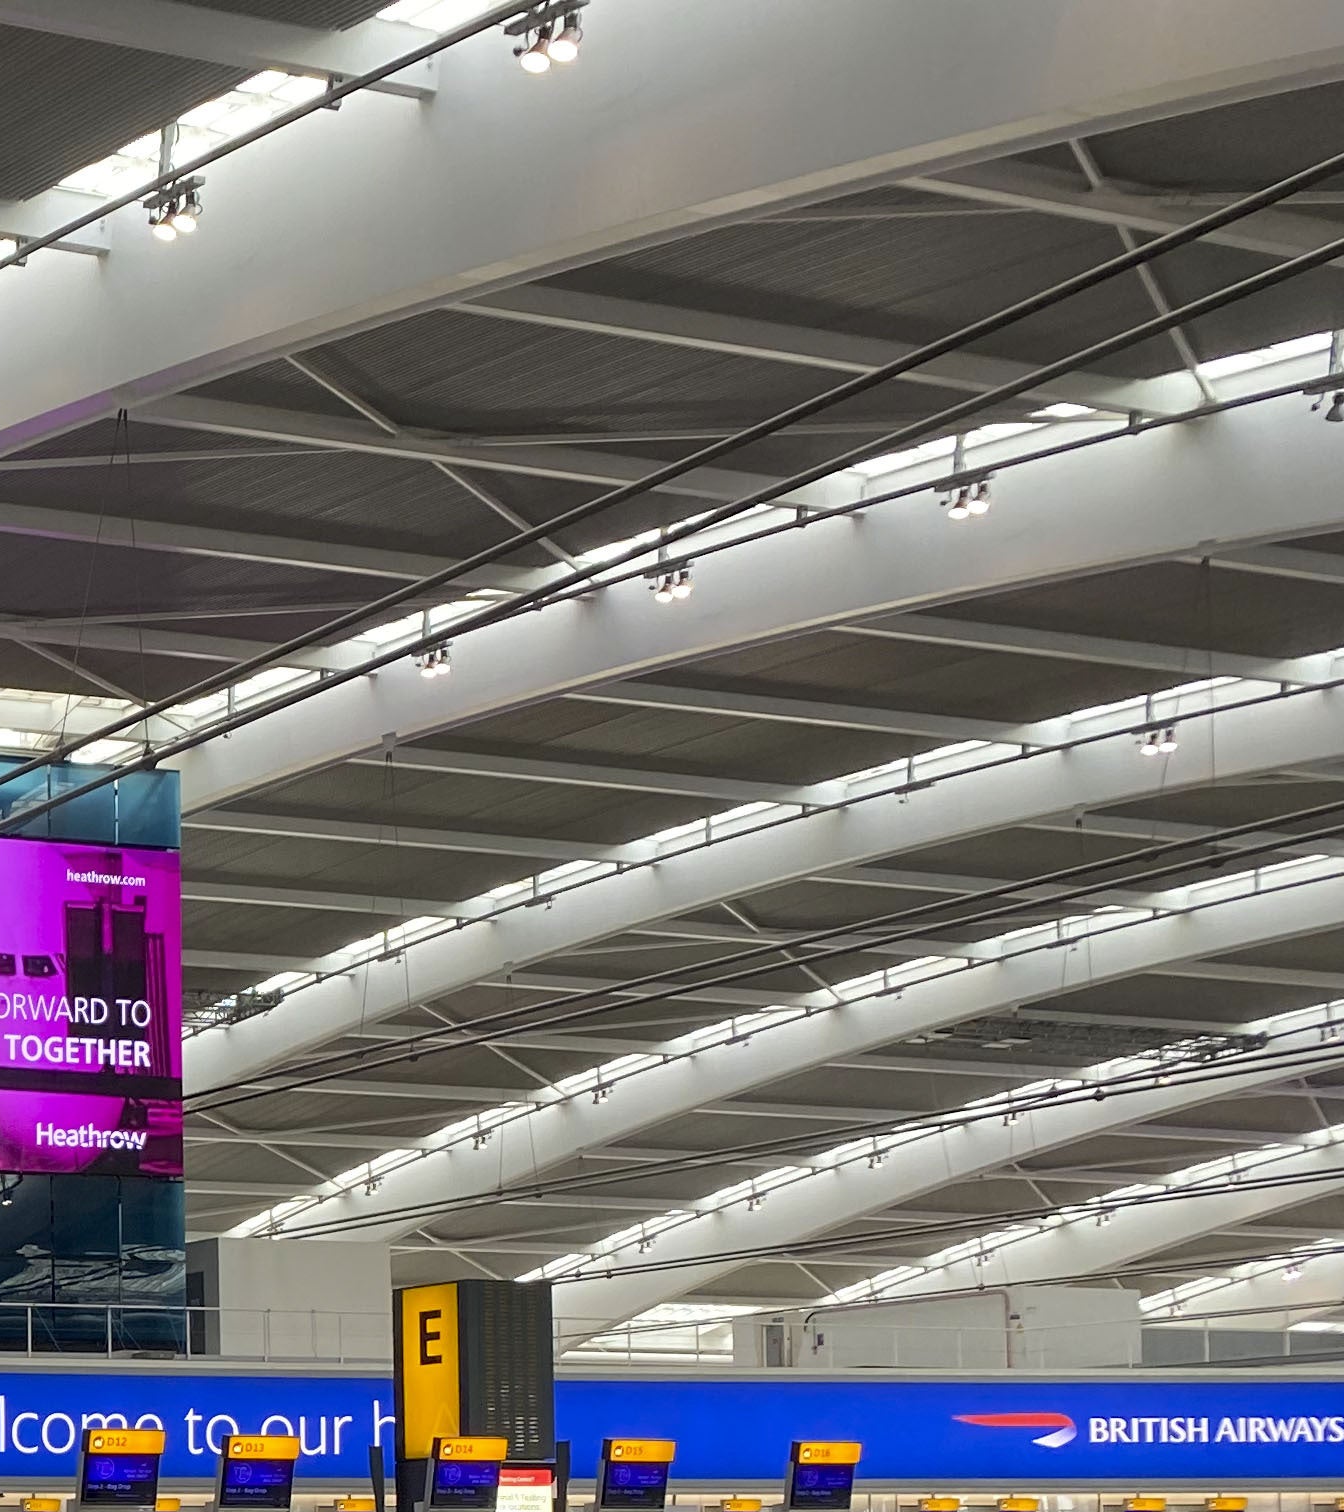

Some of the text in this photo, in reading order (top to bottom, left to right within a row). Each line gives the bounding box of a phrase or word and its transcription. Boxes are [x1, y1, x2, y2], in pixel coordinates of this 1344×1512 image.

[66, 868, 146, 887] heathrow.com
[115, 998, 151, 1027] TO
[4, 1033, 151, 1067] TOGETHER
[35, 1121, 146, 1150] Heathrow
[419, 1309, 442, 1365] E
[107, 1437, 127, 1446] D12
[185, 1408, 238, 1455] to
[1089, 1416, 1344, 1443] BRITISH AIRWAYS
[245, 1443, 264, 1452] D13
[455, 1445, 474, 1454] D14
